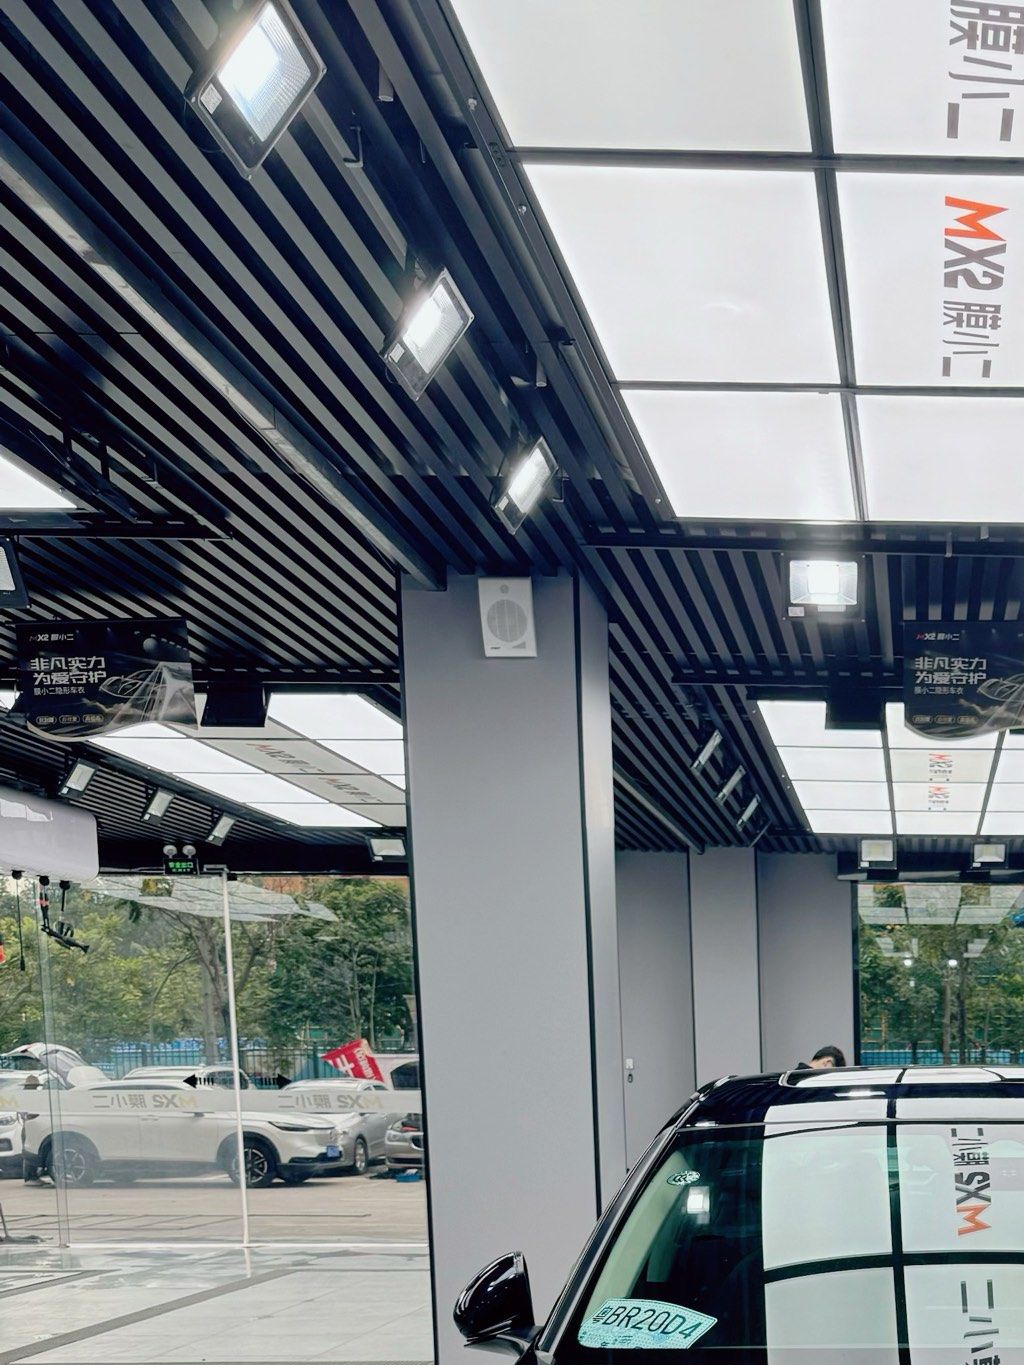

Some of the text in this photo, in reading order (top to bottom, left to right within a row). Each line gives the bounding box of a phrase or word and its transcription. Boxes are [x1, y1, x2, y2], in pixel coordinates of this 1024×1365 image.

[942, 196, 1009, 378] MX2 膜小二
[30, 656, 106, 670] 非凡实力
[914, 657, 987, 670] 非凡实力
[33, 670, 107, 685] 为爱守护
[914, 671, 987, 685] 为爱守护
